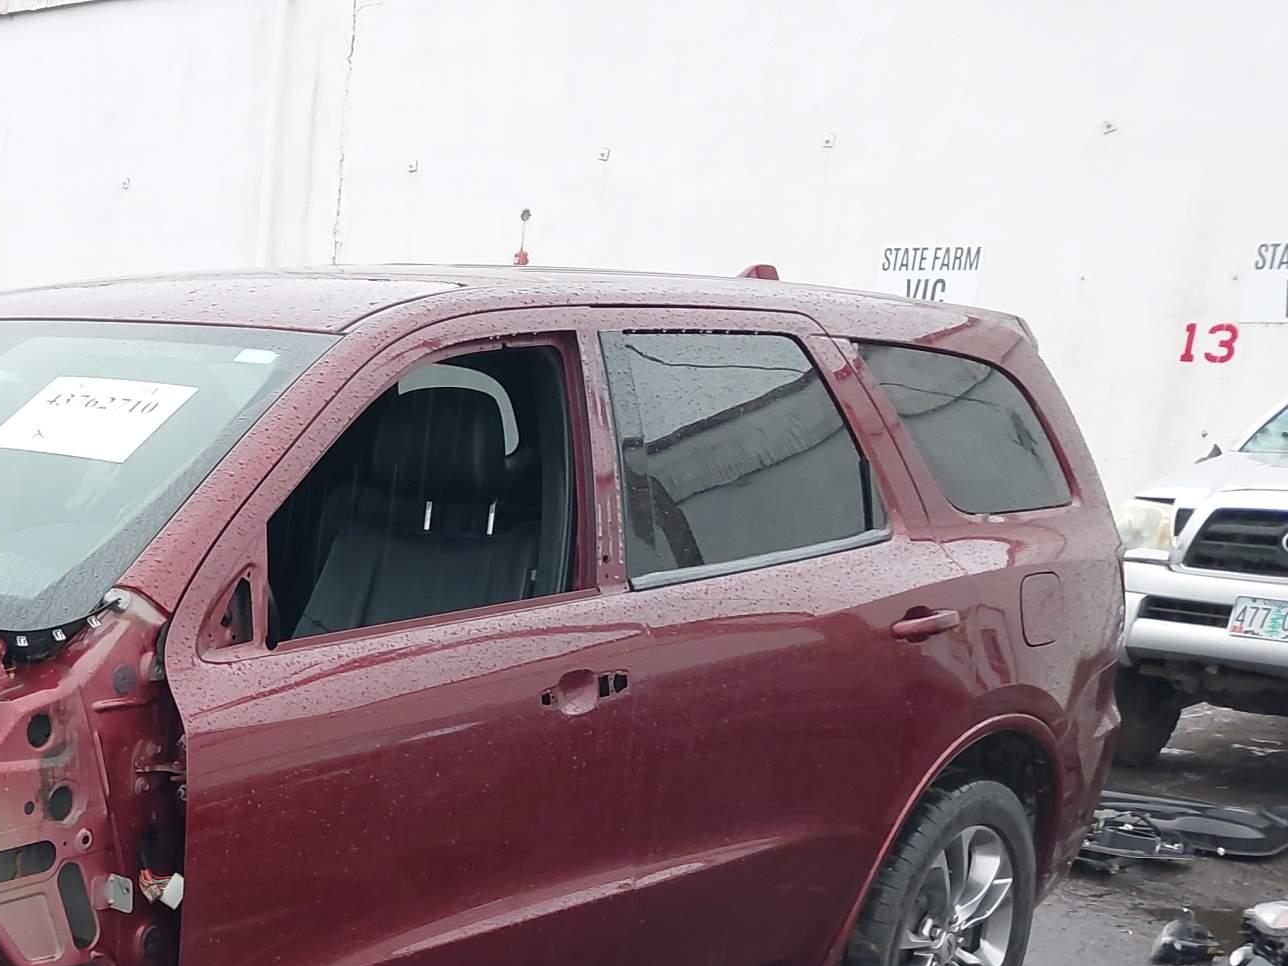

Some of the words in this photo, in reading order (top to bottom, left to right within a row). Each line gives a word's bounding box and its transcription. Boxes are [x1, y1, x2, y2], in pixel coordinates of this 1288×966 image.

[882, 247, 929, 271] STATE
[931, 246, 982, 271] FARM
[1179, 322, 1239, 364] 13
[46, 393, 160, 415] 43762710
